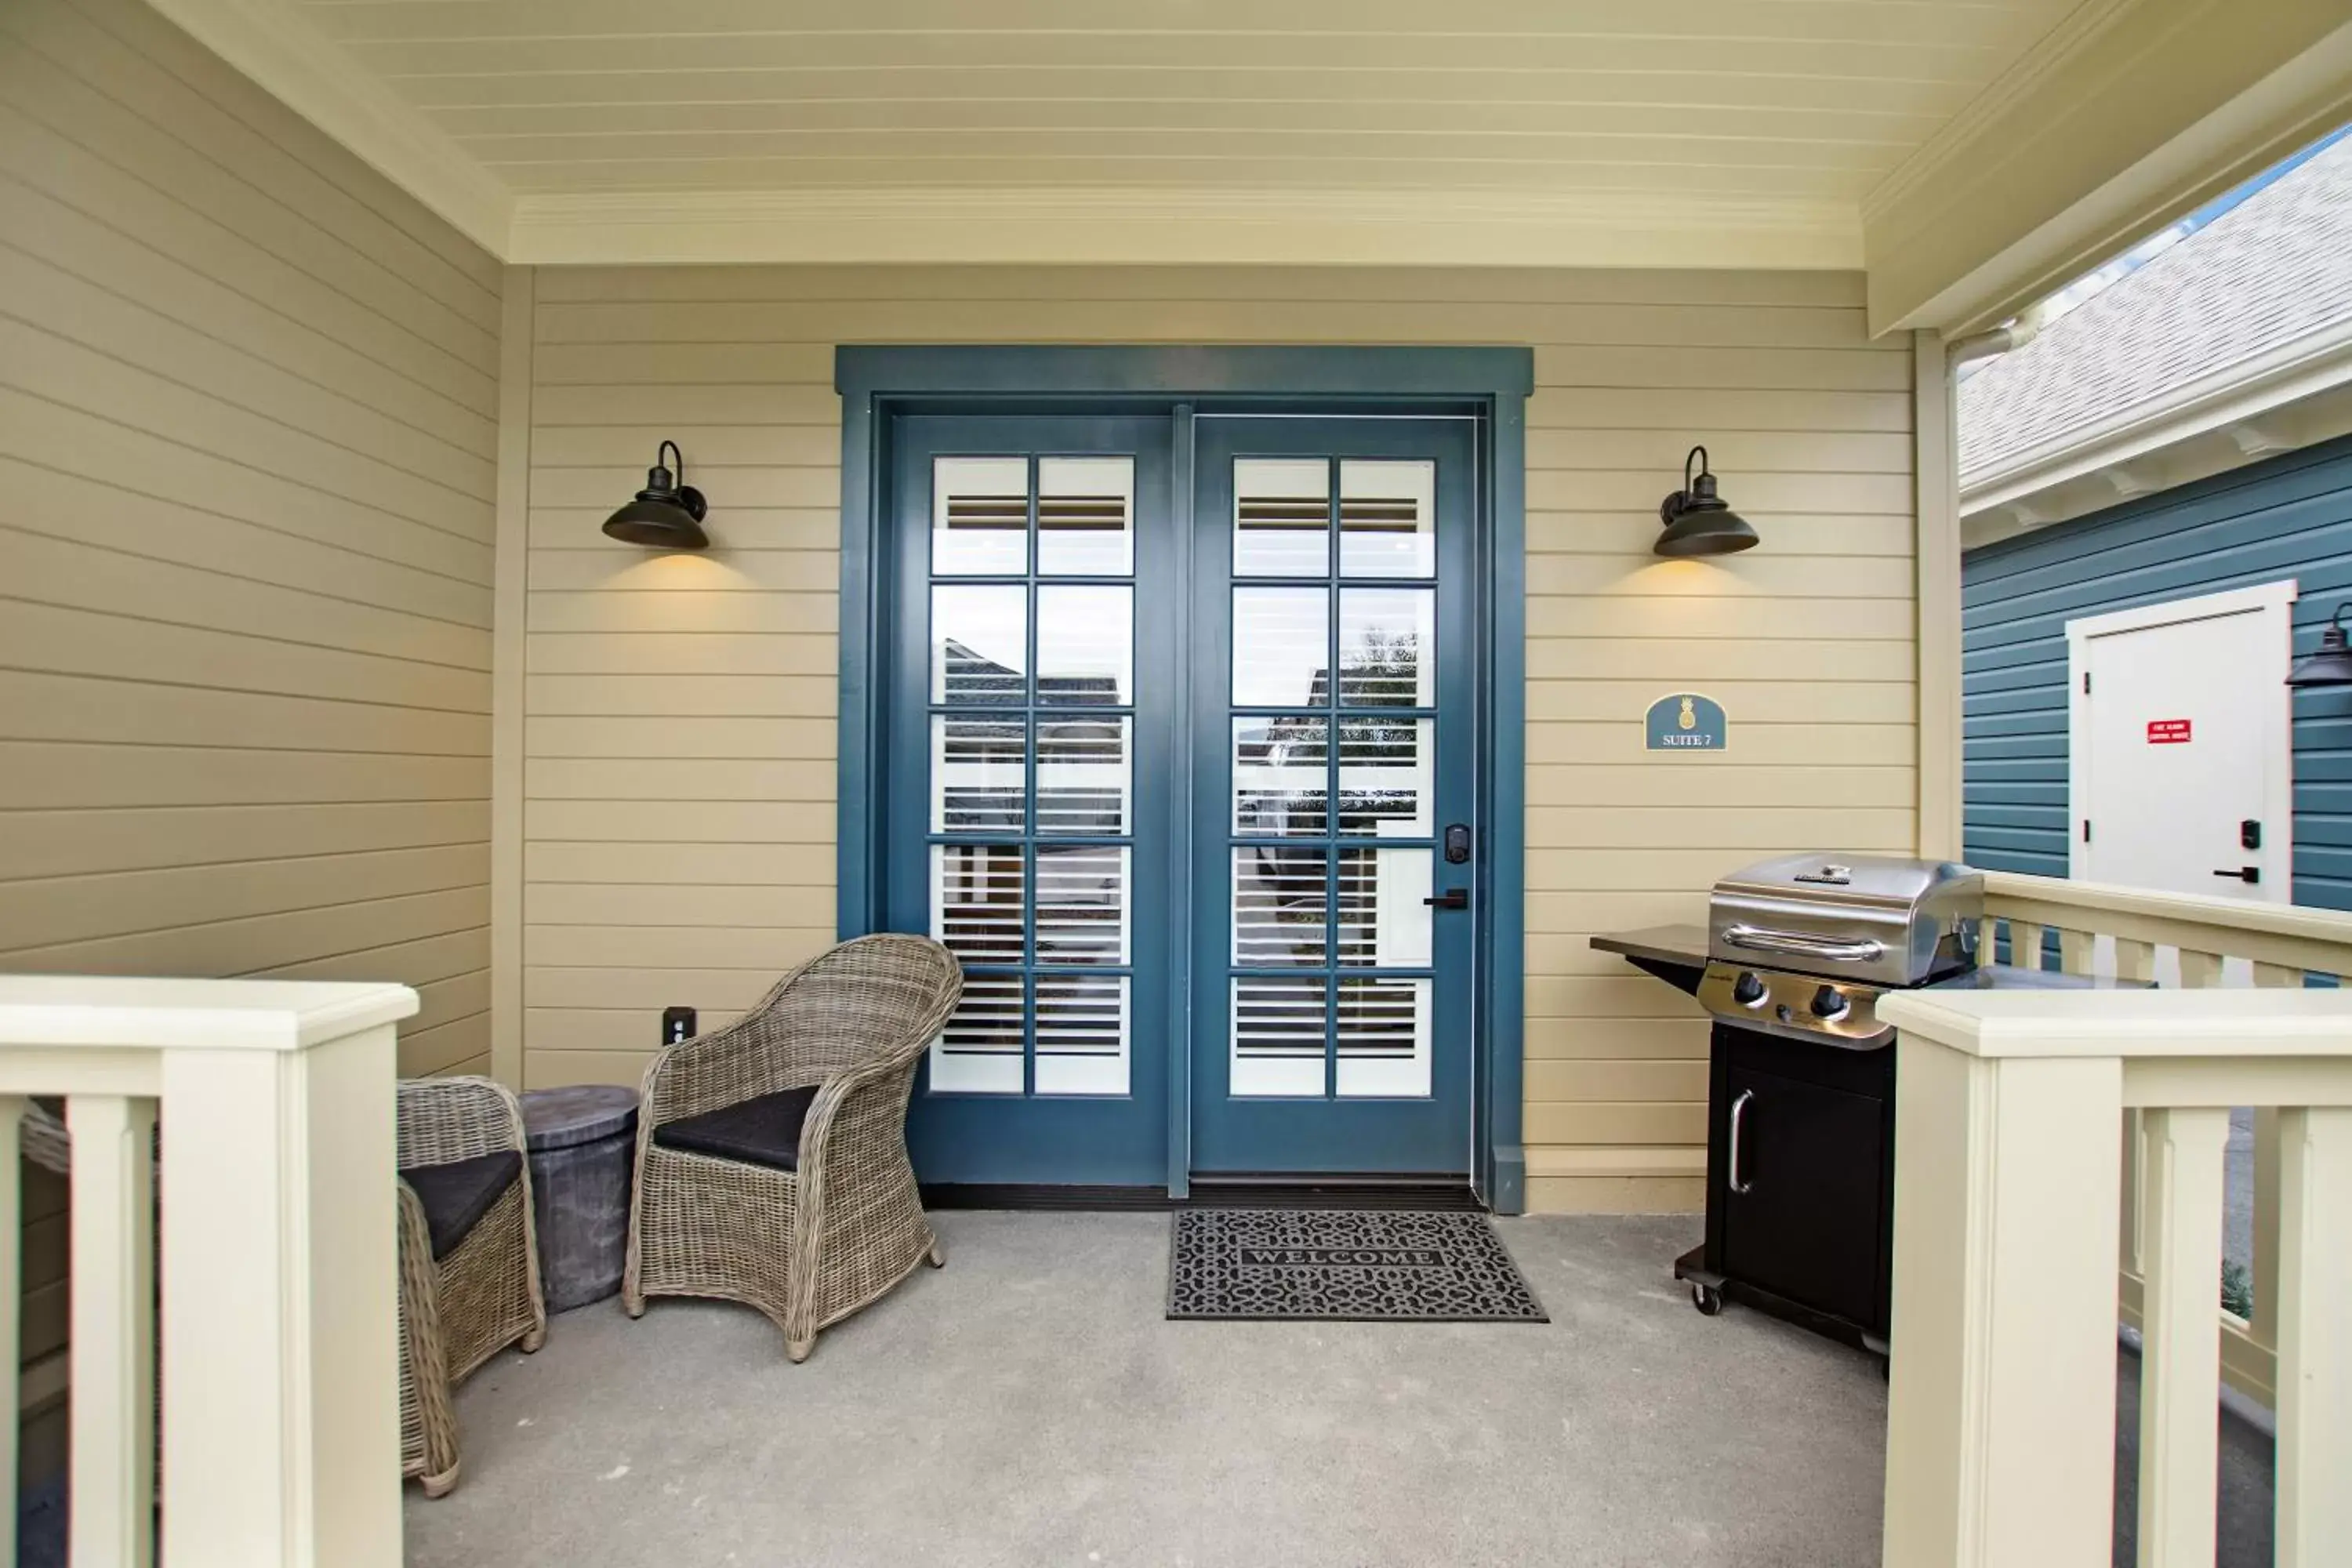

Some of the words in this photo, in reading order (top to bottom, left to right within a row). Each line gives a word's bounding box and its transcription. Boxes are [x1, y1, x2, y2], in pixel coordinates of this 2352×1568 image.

[1662, 735, 1702, 746] SUITE
[1704, 734, 1711, 746] 7
[1248, 1250, 1435, 1265] WELCOME
